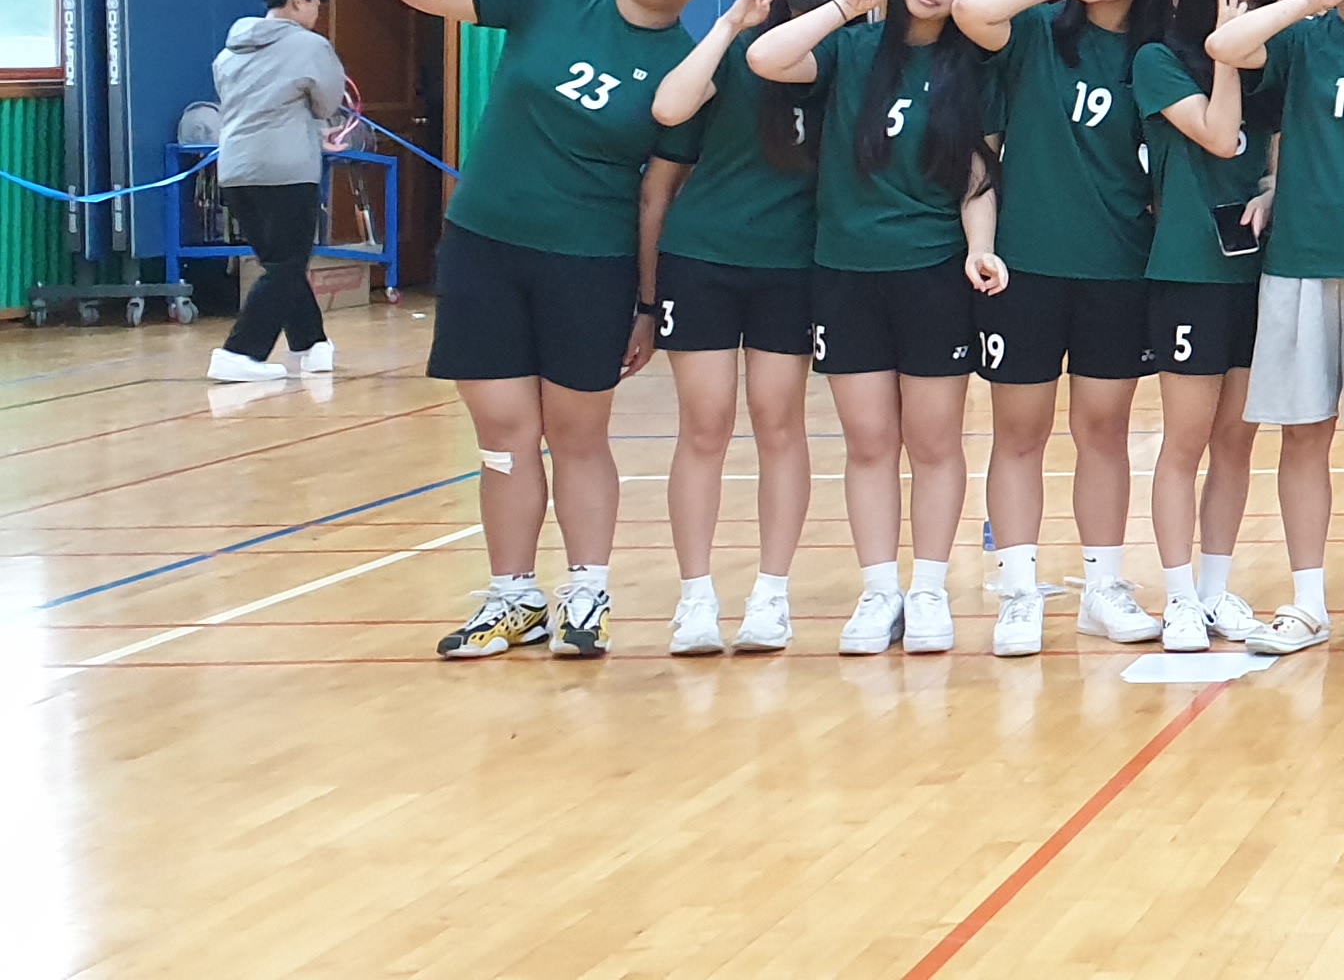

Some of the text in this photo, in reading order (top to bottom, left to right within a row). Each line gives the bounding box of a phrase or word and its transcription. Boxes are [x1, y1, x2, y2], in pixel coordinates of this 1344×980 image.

[555, 61, 622, 110] 23
[1071, 81, 1113, 127] 19
[659, 300, 675, 337] 3
[979, 331, 1006, 370] 19
